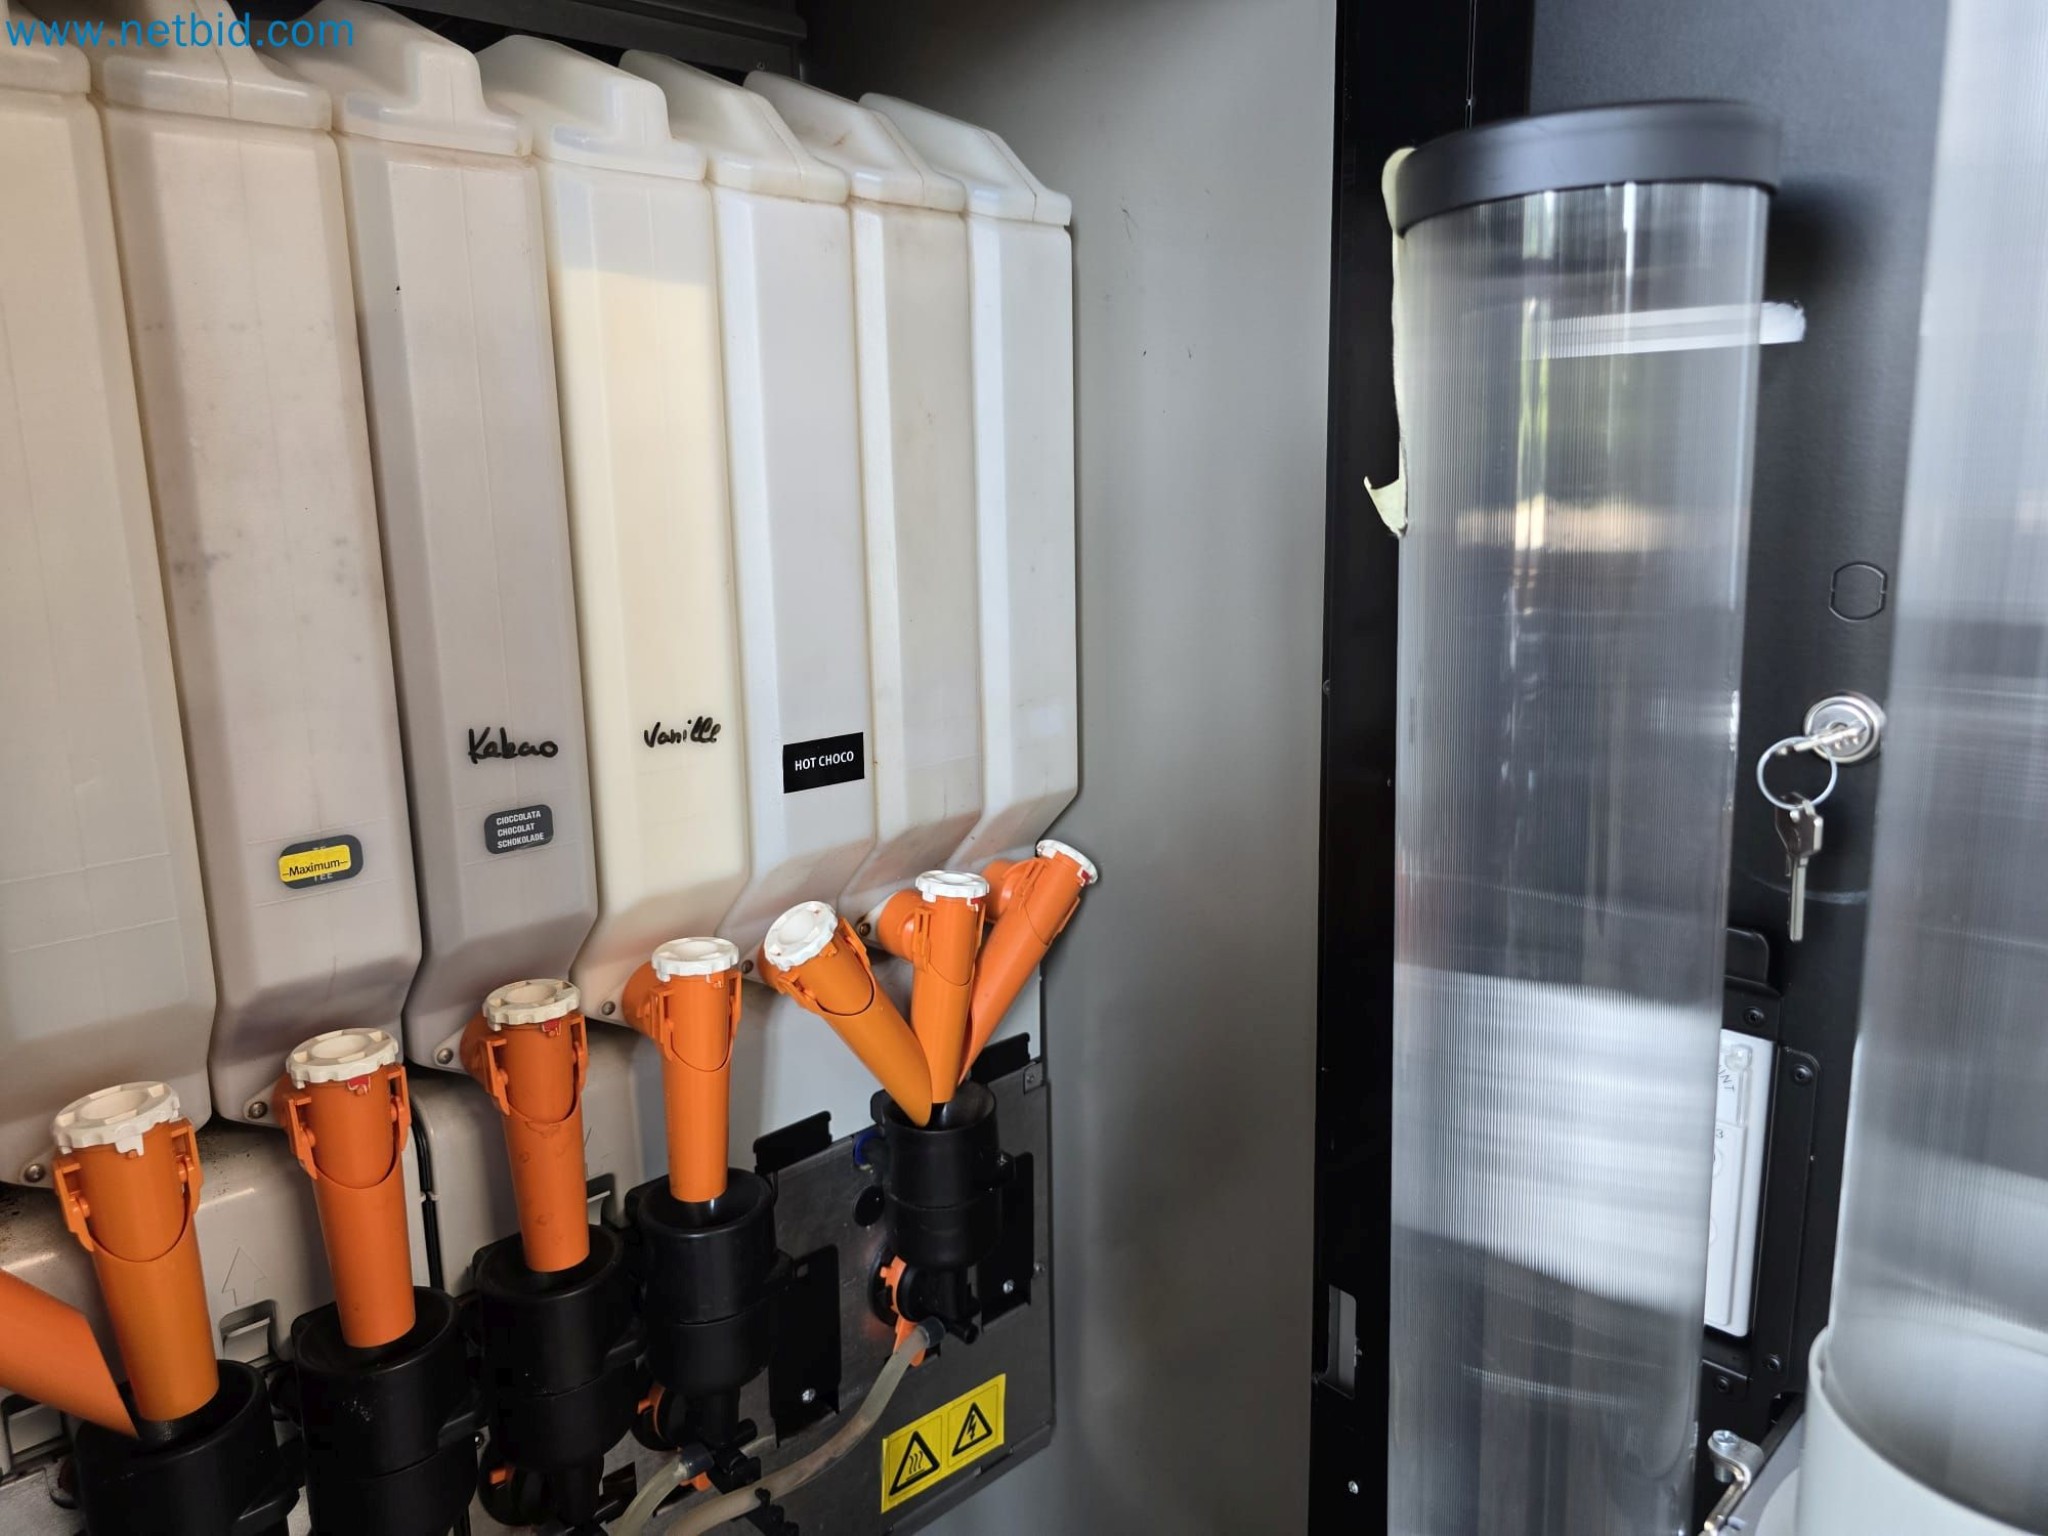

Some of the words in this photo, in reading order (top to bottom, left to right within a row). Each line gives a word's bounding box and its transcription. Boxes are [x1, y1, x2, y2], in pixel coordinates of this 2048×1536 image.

[643, 715, 722, 748] Vanille
[794, 757, 817, 771] HOT
[818, 750, 855, 767] CHOCO
[495, 810, 542, 826] CIOCCOLATA
[496, 822, 536, 837] CHOCOLAT
[496, 832, 545, 849] SCHOKOLADE
